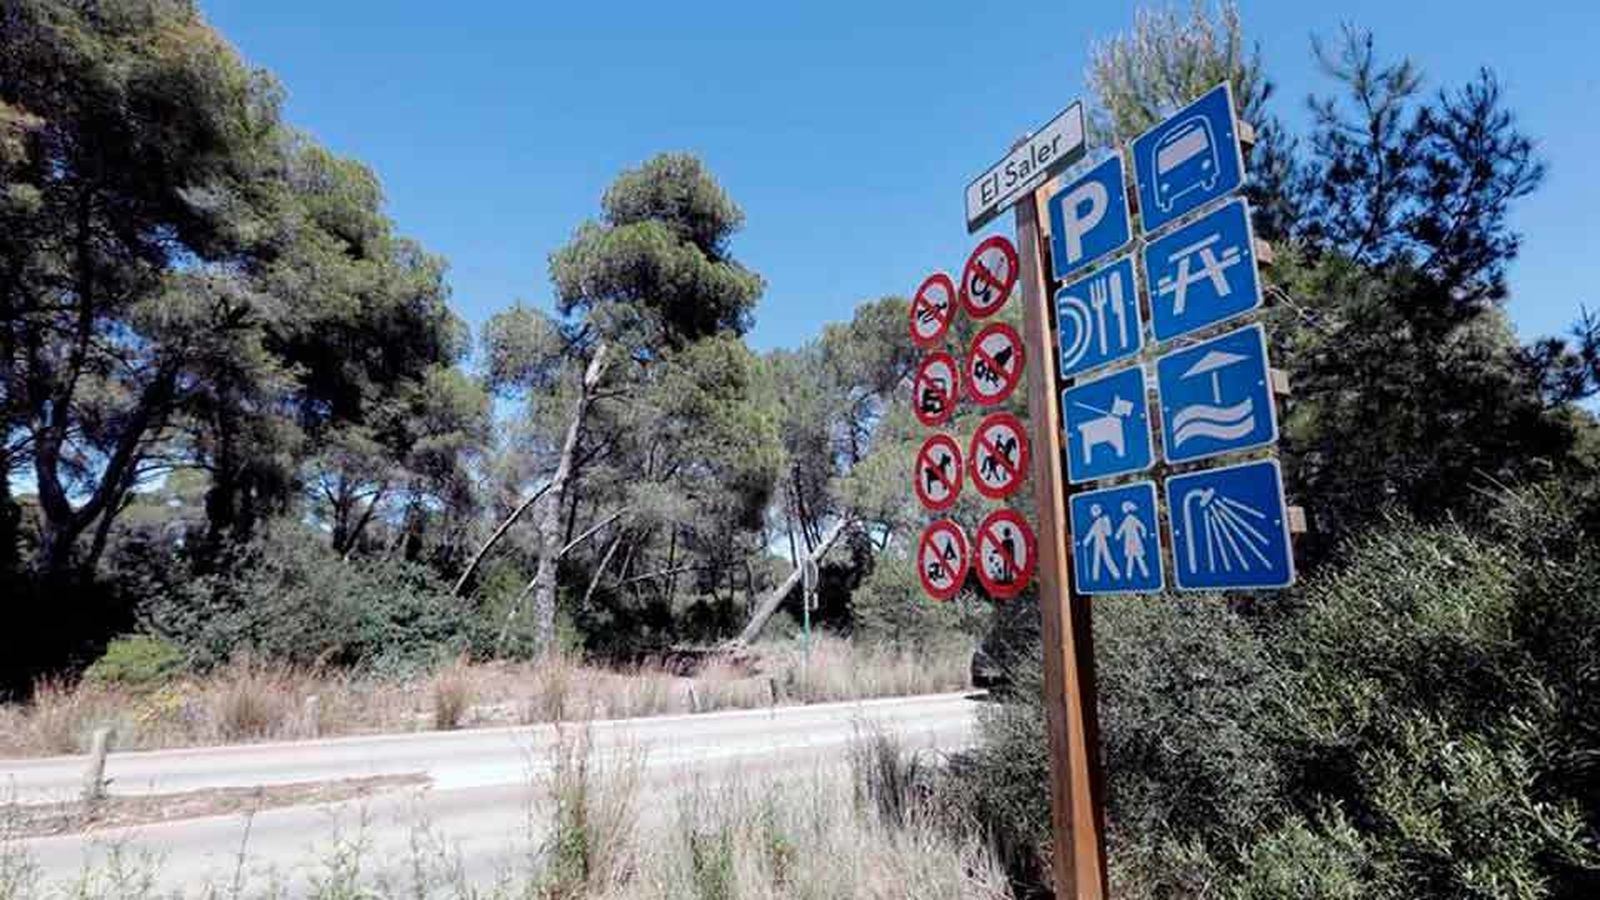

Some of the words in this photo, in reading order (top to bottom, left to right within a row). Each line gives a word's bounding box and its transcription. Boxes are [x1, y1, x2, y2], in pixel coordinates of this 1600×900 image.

[980, 172, 999, 205] El
[1004, 133, 1062, 188] Saler
[1061, 180, 1109, 264] P
